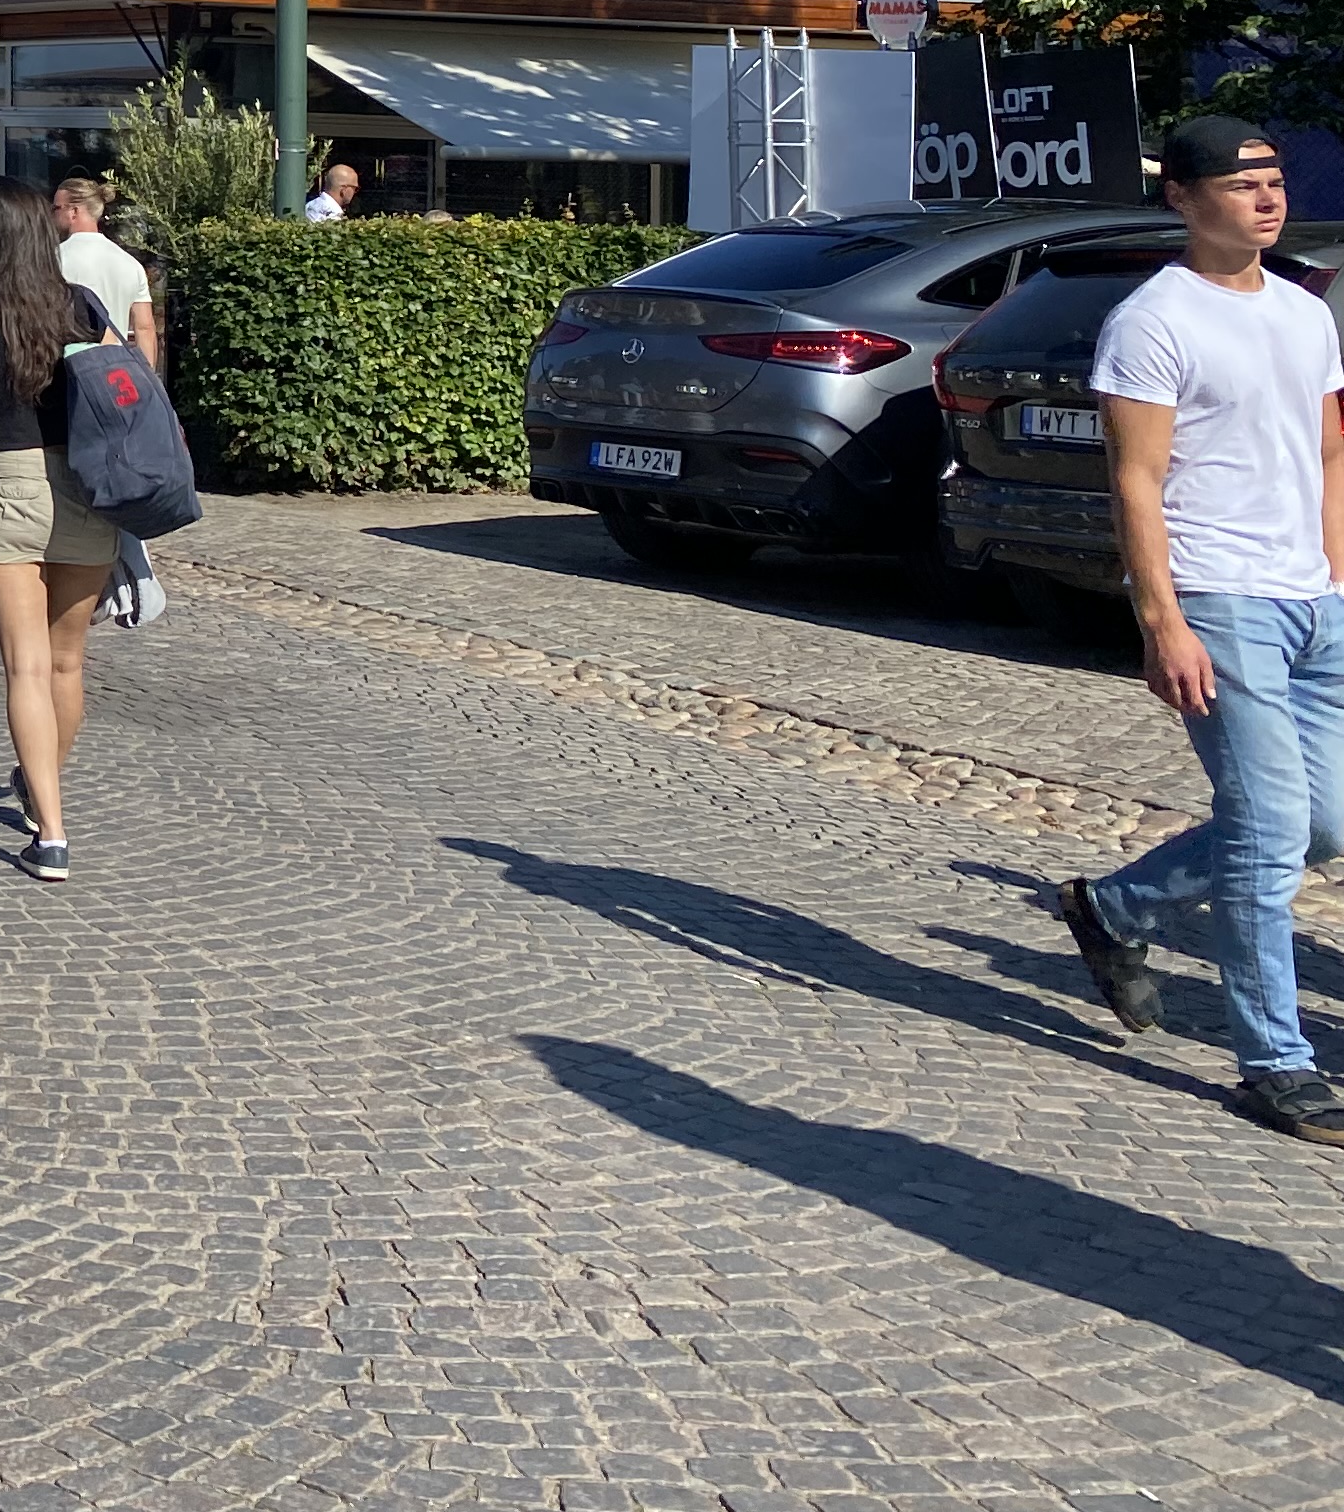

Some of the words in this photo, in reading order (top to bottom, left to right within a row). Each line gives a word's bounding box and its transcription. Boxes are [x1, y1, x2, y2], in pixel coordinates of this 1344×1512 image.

[869, 1, 927, 15] MAMAS
[990, 86, 1053, 115] LOFT
[994, 121, 1092, 188] ord
[107, 368, 140, 407] 3
[1039, 409, 1080, 434] WYT
[604, 443, 636, 468] LFA
[641, 449, 675, 472] 92W
